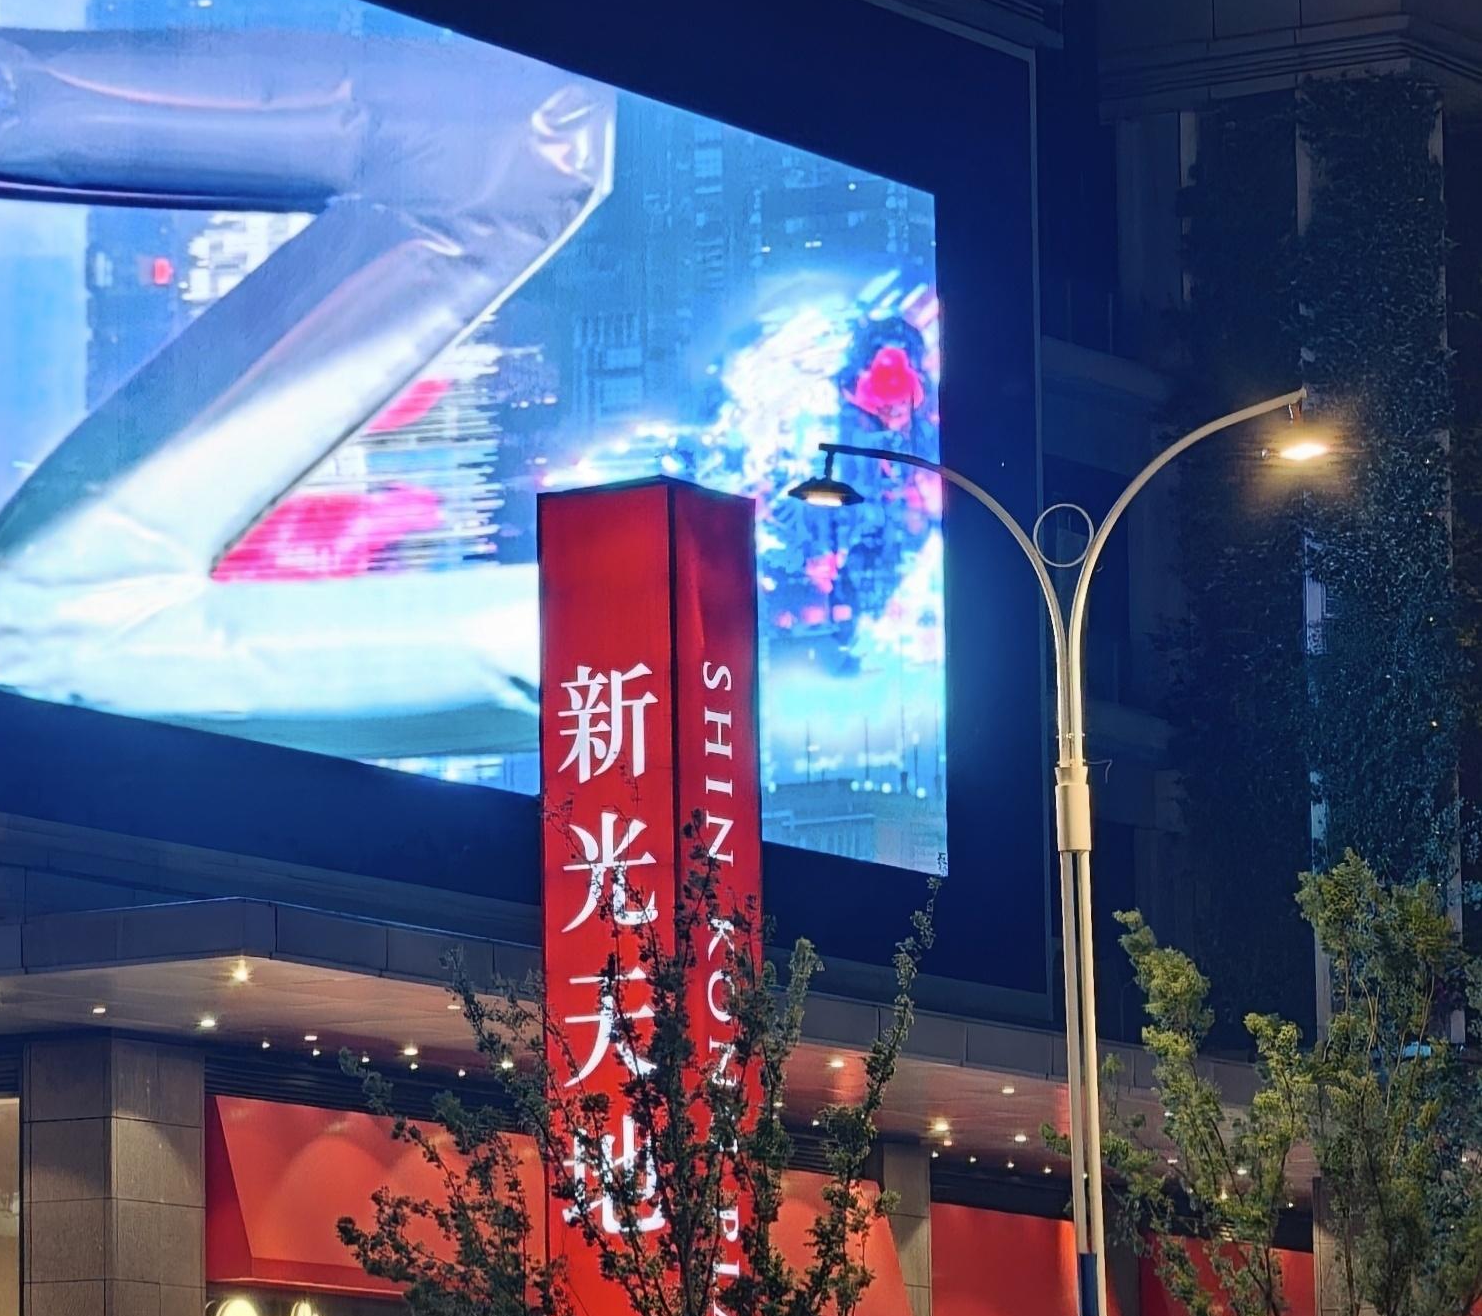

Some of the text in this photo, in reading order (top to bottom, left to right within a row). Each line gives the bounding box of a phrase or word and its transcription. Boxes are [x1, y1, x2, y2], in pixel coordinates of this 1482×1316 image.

[557, 661, 667, 1235] 新光天地
[702, 660, 735, 868] SHIN
